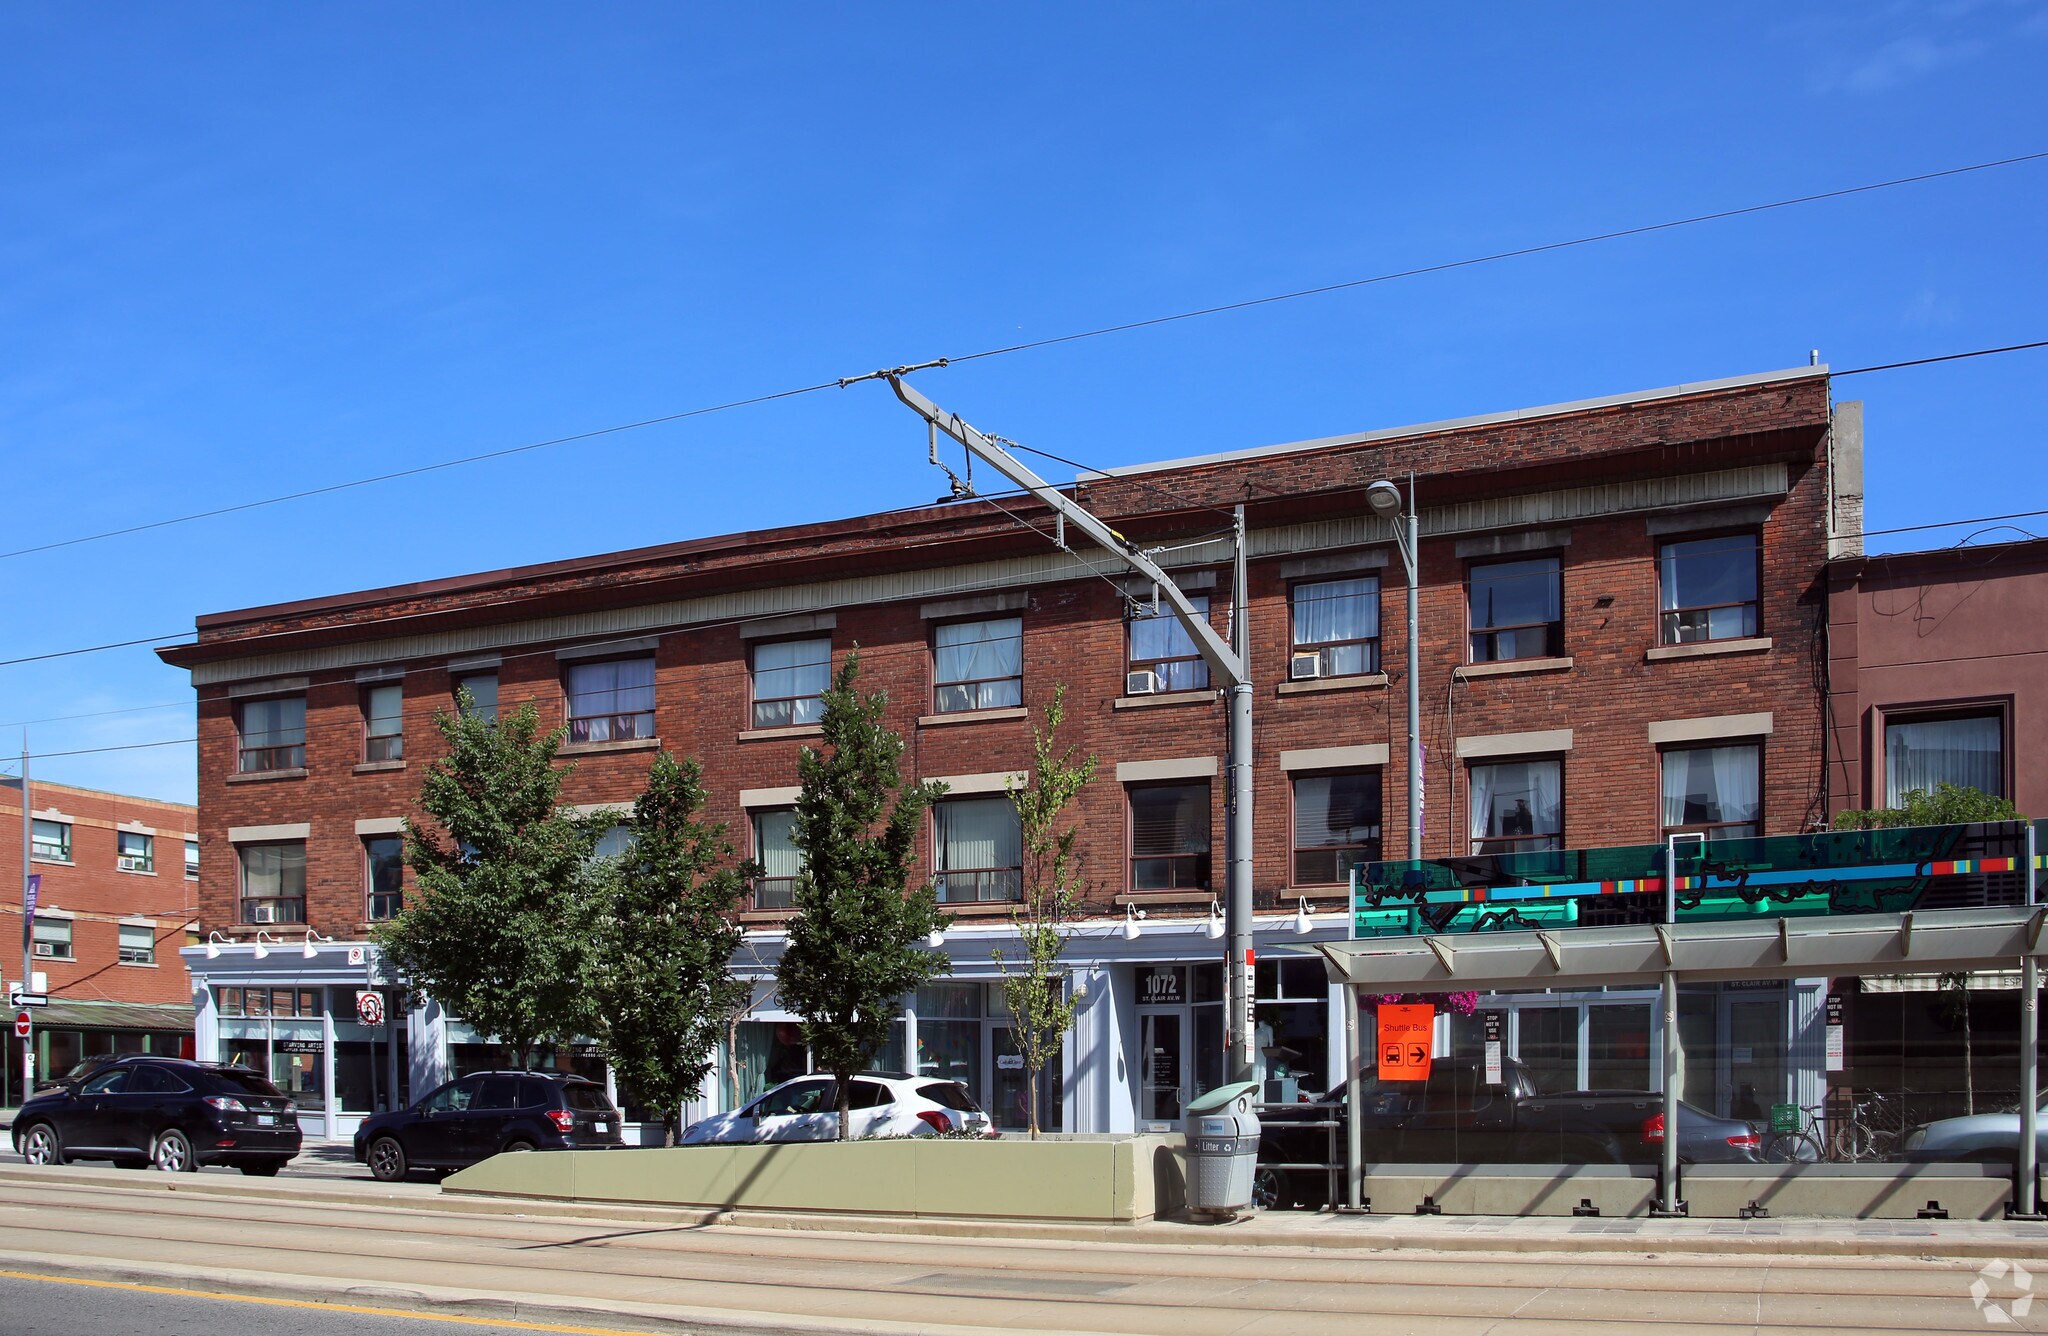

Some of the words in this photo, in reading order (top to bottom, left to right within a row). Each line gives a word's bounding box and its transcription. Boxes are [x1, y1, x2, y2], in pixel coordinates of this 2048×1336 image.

[1145, 974, 1177, 994] 1072
[1384, 1023, 1410, 1032] Shuttle
[1412, 1023, 1427, 1032] Bus
[1202, 1141, 1220, 1152] Litter
